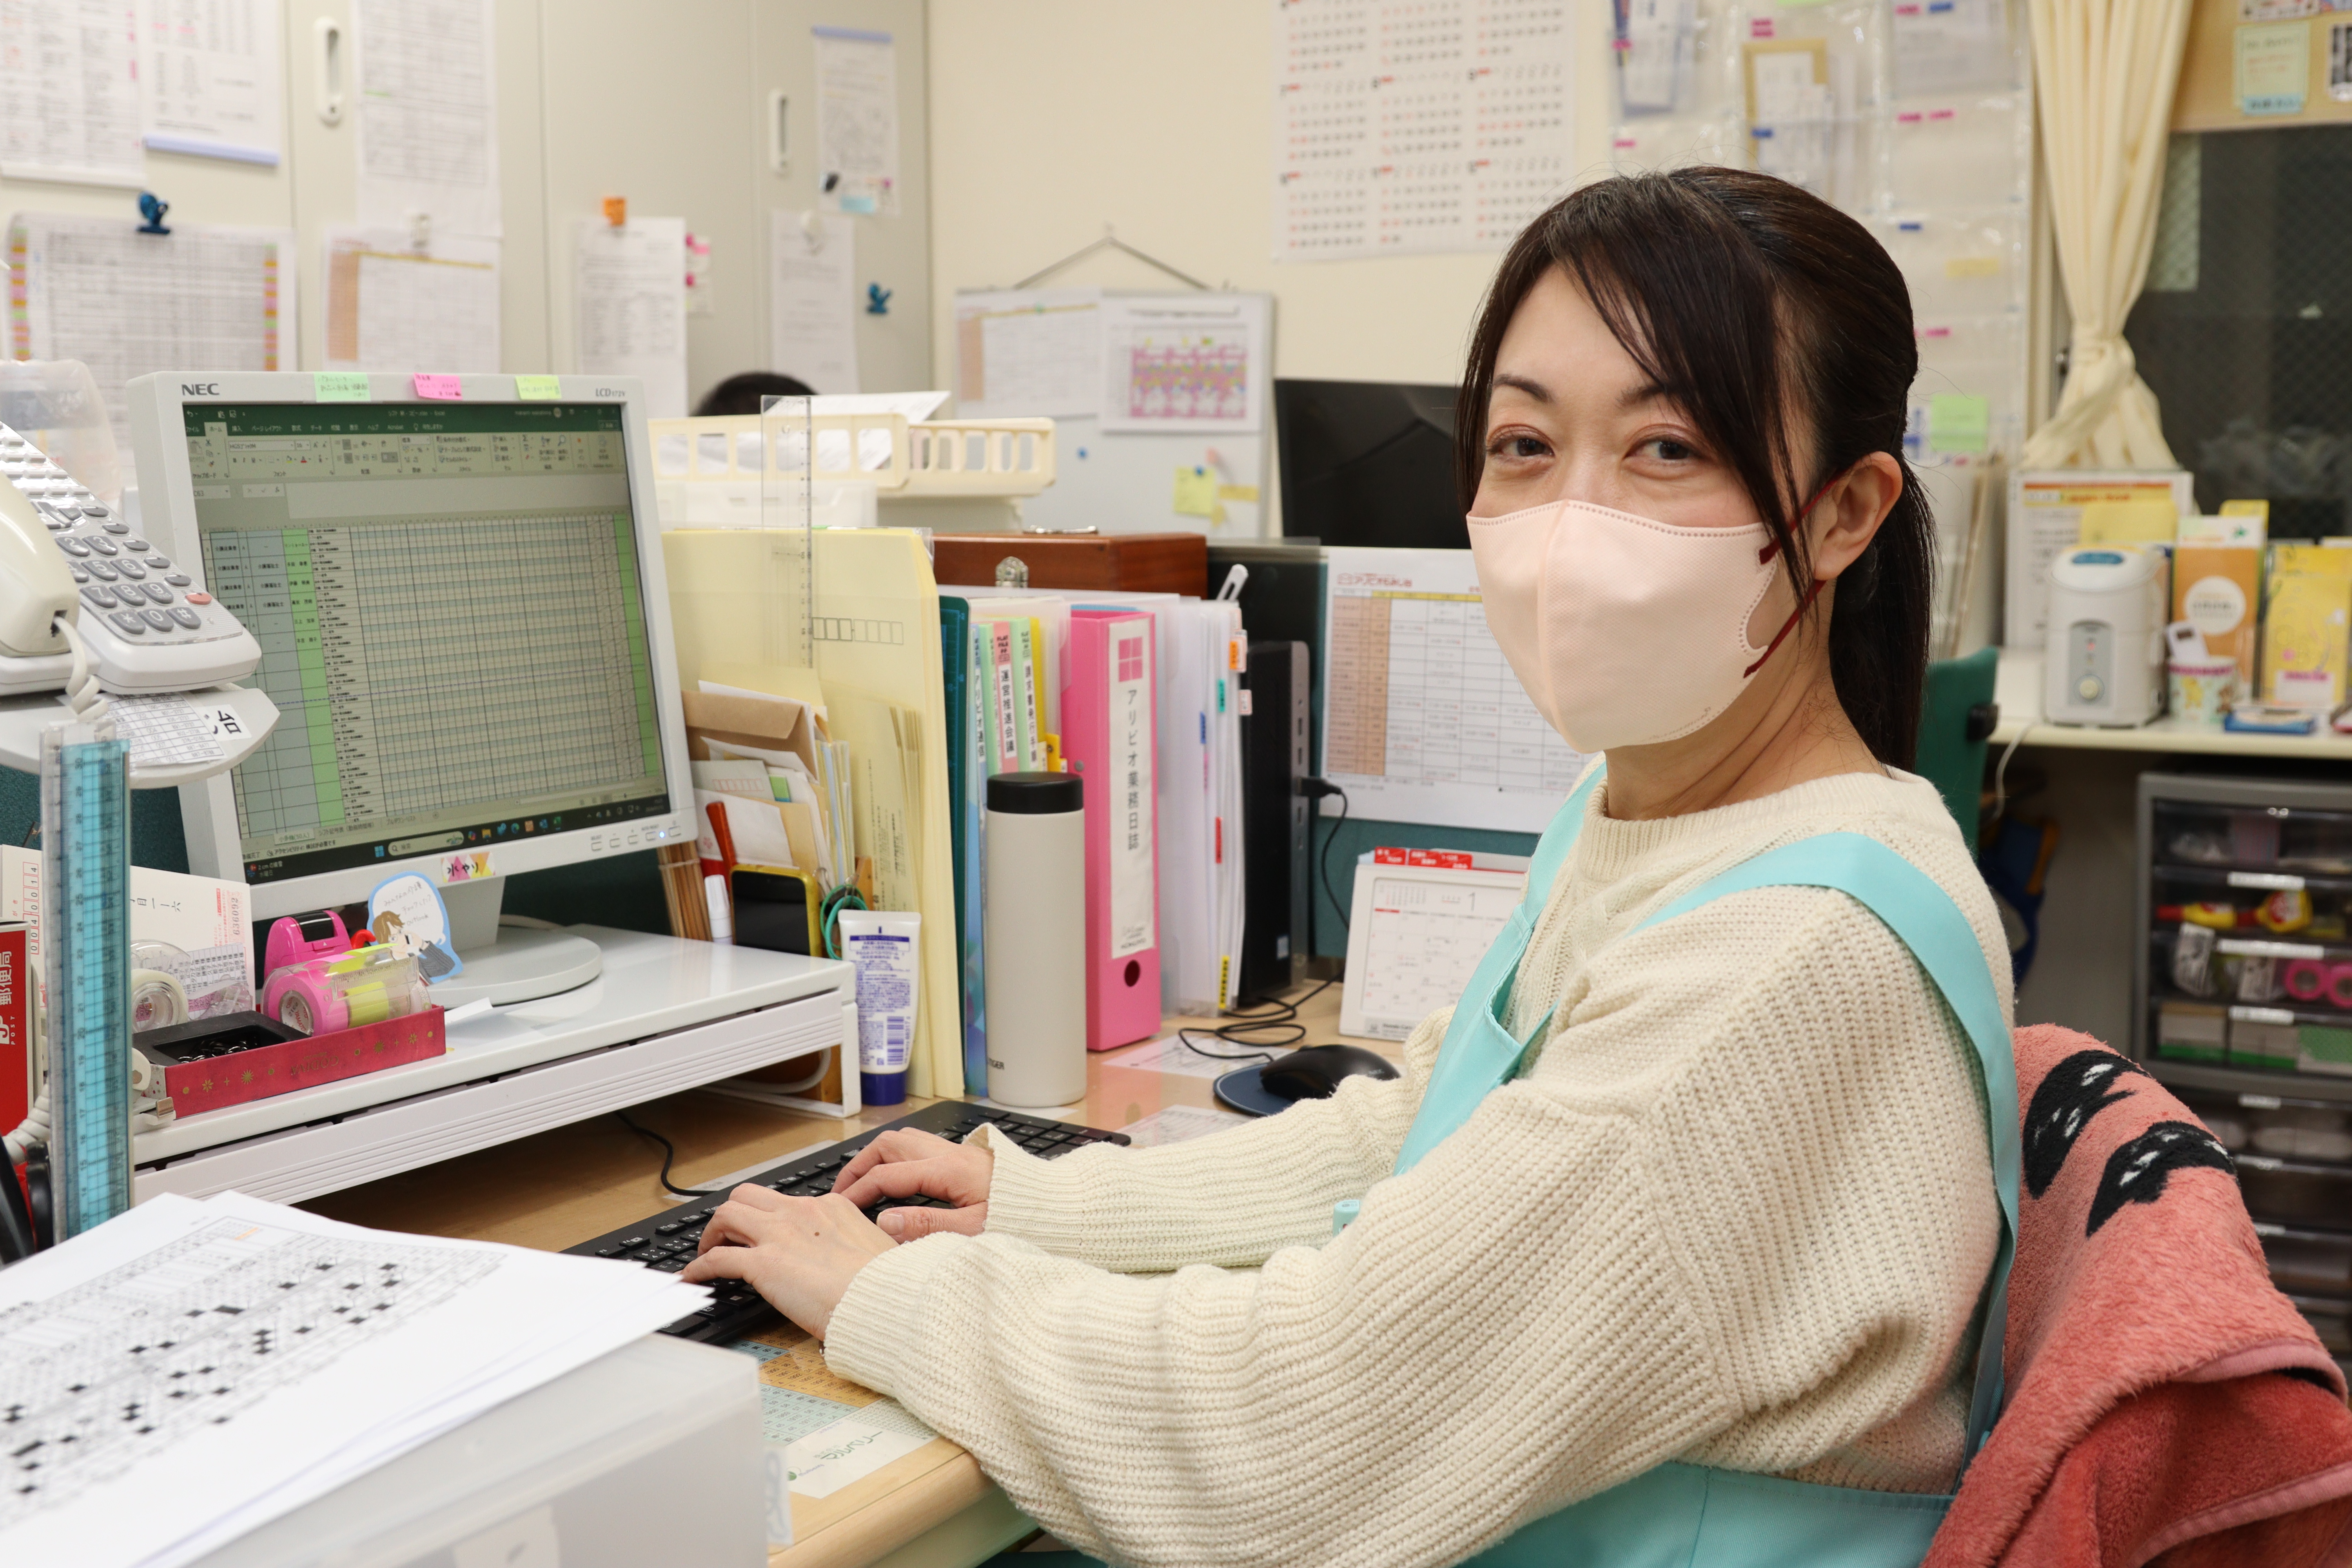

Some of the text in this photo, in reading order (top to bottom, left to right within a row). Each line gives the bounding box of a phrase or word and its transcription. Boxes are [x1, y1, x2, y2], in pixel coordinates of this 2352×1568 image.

[181, 383, 220, 396] NEC
[65, 537, 75, 547] 2
[93, 536, 107, 546] 3
[92, 561, 107, 571] 5
[122, 559, 137, 570] 6
[92, 586, 105, 597] 7
[120, 585, 136, 595] 8
[149, 583, 164, 594] 9
[149, 610, 163, 621] 0
[447, 862, 479, 874] 水やり
[231, 897, 240, 935] 636092
[294, 1010, 307, 1032] YAMATO
[291, 1055, 339, 1075] GODIVA
[799, 1417, 815, 1426] 1971
[811, 1420, 827, 1428] 1972
